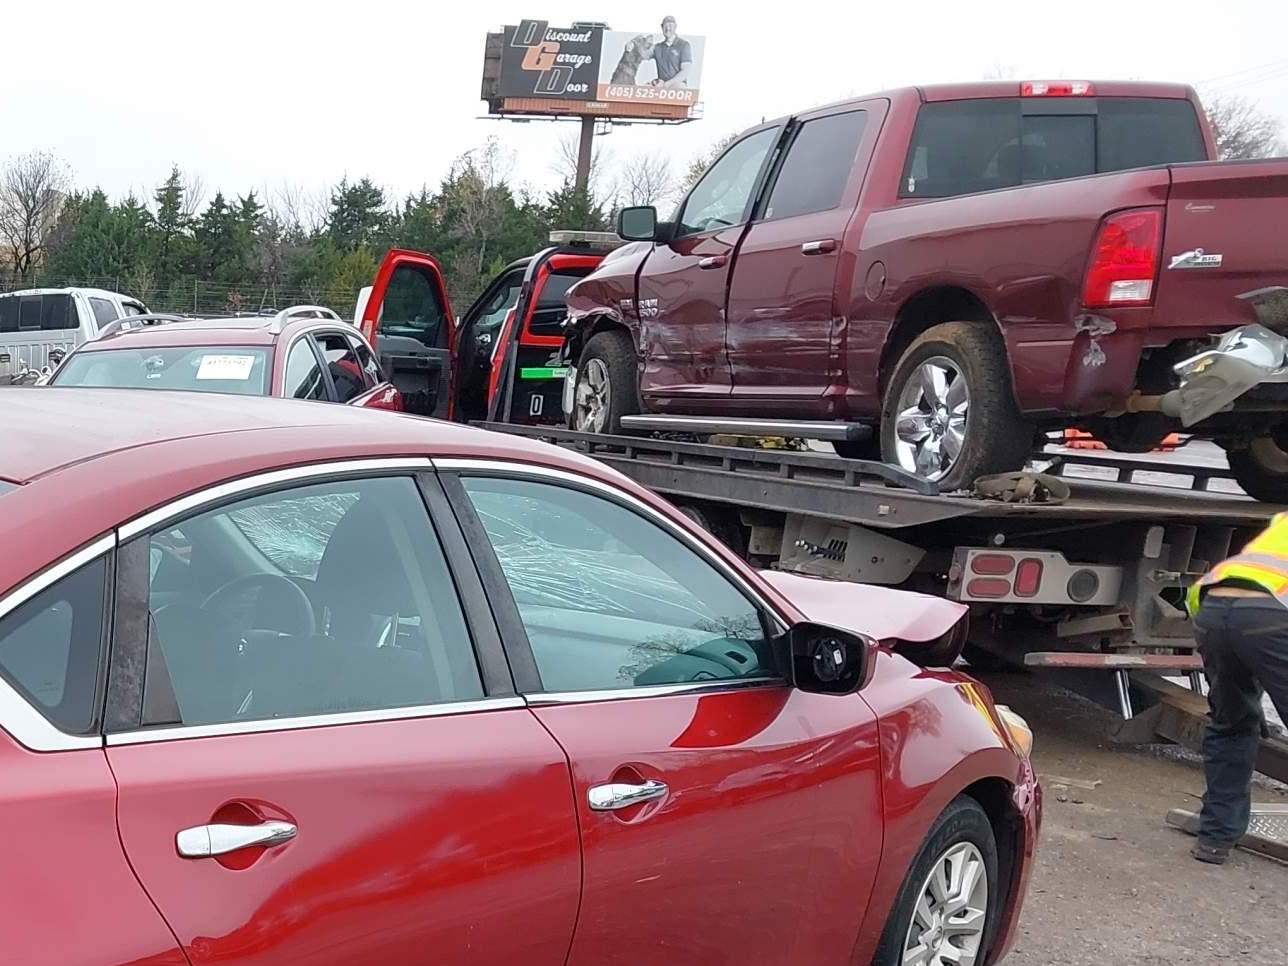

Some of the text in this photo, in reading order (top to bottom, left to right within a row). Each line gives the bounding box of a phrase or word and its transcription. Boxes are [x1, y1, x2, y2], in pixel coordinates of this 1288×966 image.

[510, 19, 592, 48] Discount
[521, 41, 592, 70] Garage
[533, 66, 589, 95] Door
[635, 88, 693, 101] 525-DOOR
